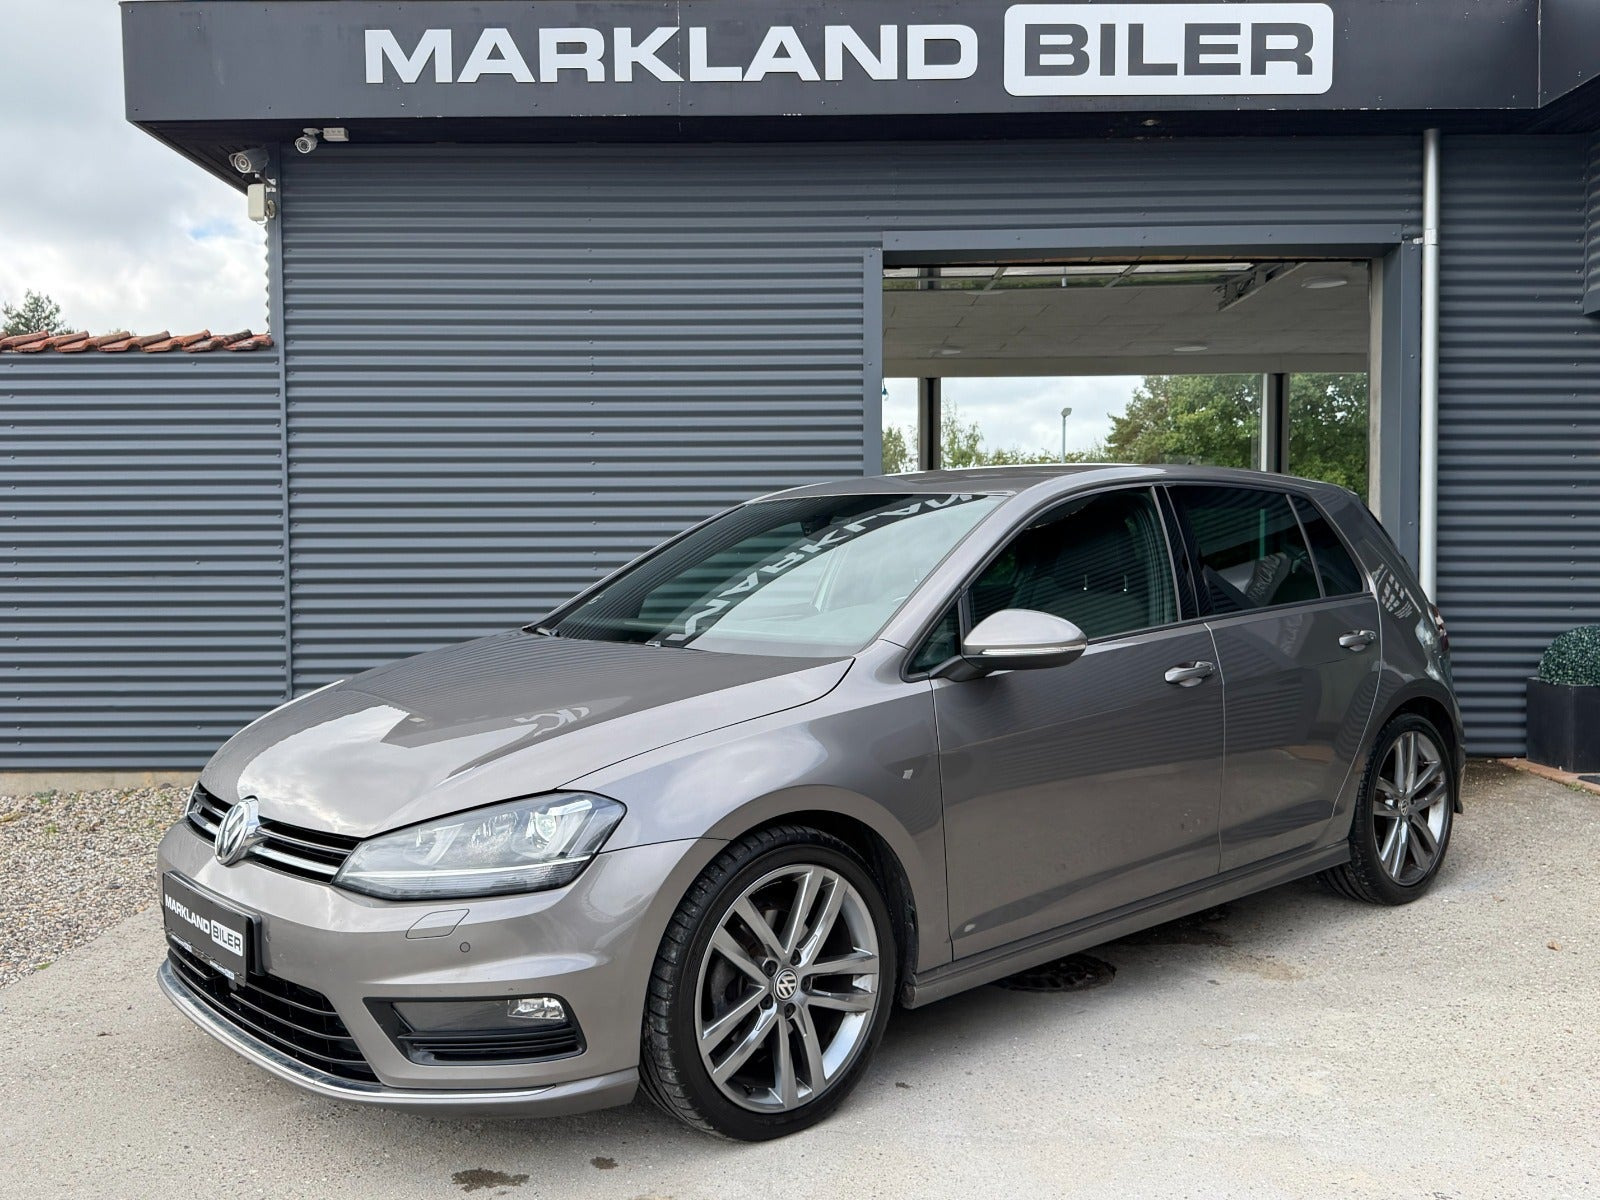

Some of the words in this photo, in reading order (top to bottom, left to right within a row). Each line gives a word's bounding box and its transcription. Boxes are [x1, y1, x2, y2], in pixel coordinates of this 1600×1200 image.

[364, 24, 979, 84] MARKLAND
[1024, 22, 1314, 77] BILER
[165, 893, 210, 935] MARKLAND
[213, 925, 241, 952] BILER
